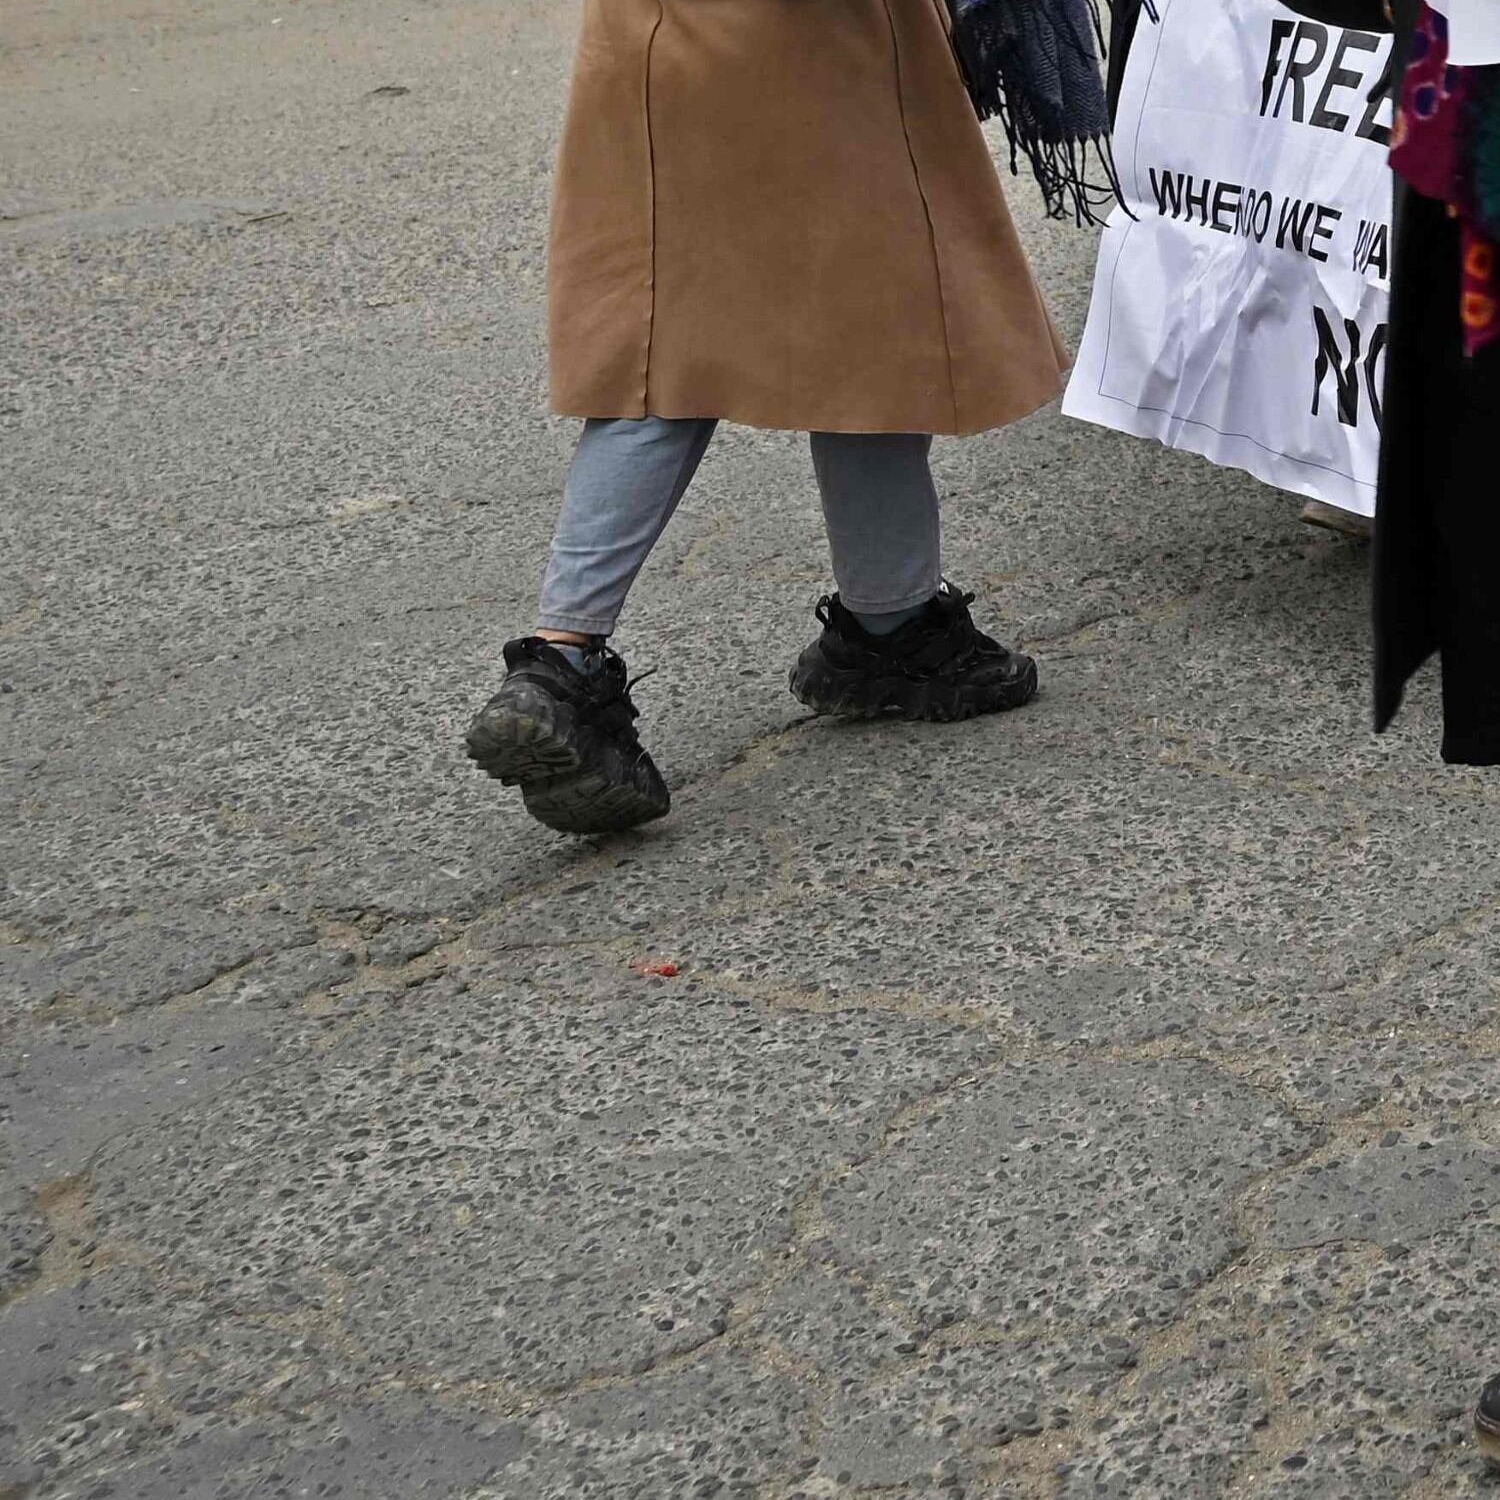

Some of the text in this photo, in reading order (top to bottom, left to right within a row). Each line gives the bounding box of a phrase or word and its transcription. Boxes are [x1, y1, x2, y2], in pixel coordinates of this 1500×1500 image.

[1149, 167, 1247, 236] WHEN
[1276, 197, 1343, 262] WE
[1353, 219, 1389, 280] WA
